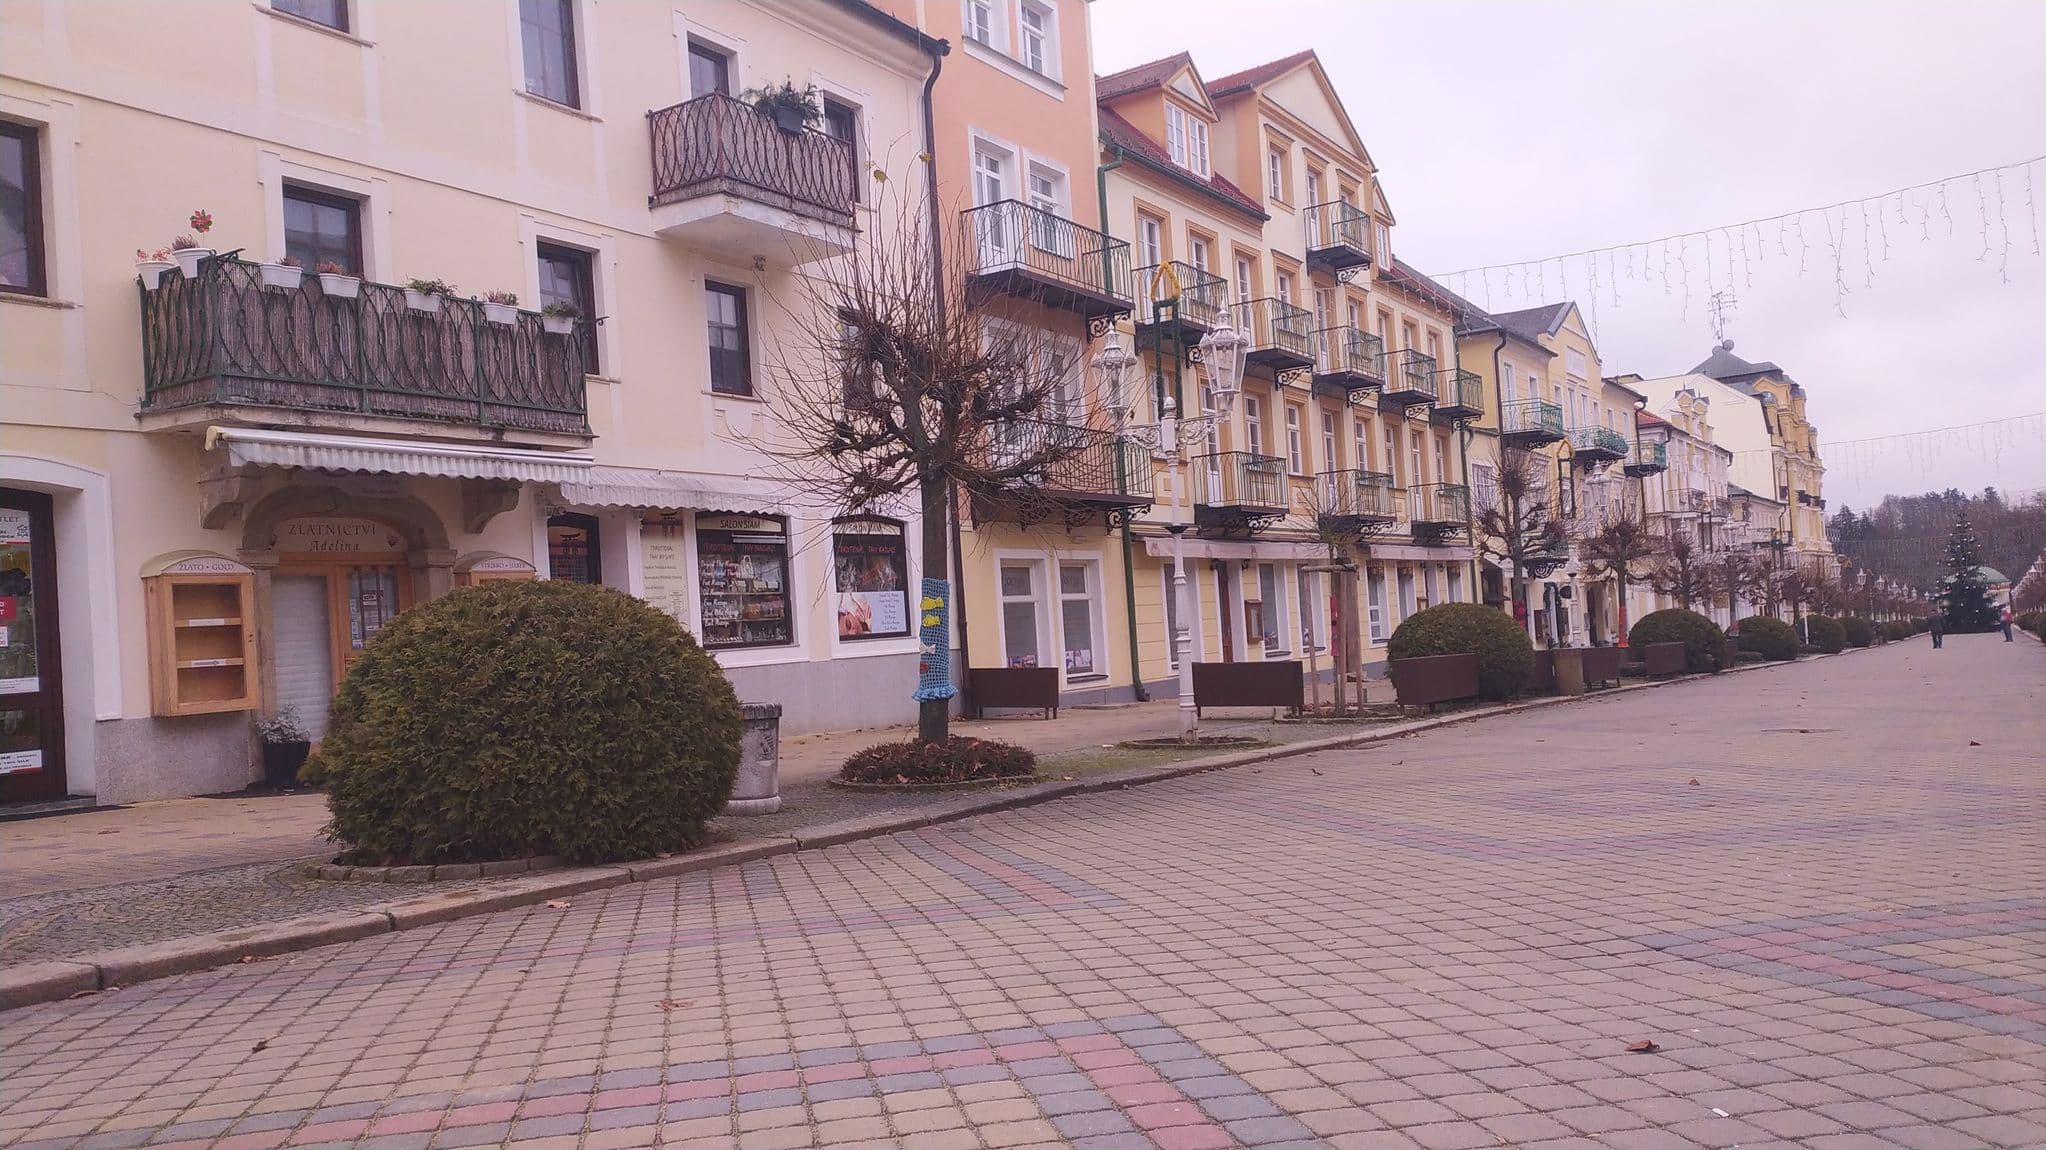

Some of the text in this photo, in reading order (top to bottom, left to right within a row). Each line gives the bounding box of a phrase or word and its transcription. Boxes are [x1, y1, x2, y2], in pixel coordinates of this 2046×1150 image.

[720, 519, 761, 529] SALON SIAM
[310, 540, 360, 551] Adelina
[179, 563, 235, 571] ZLATO GOLD
